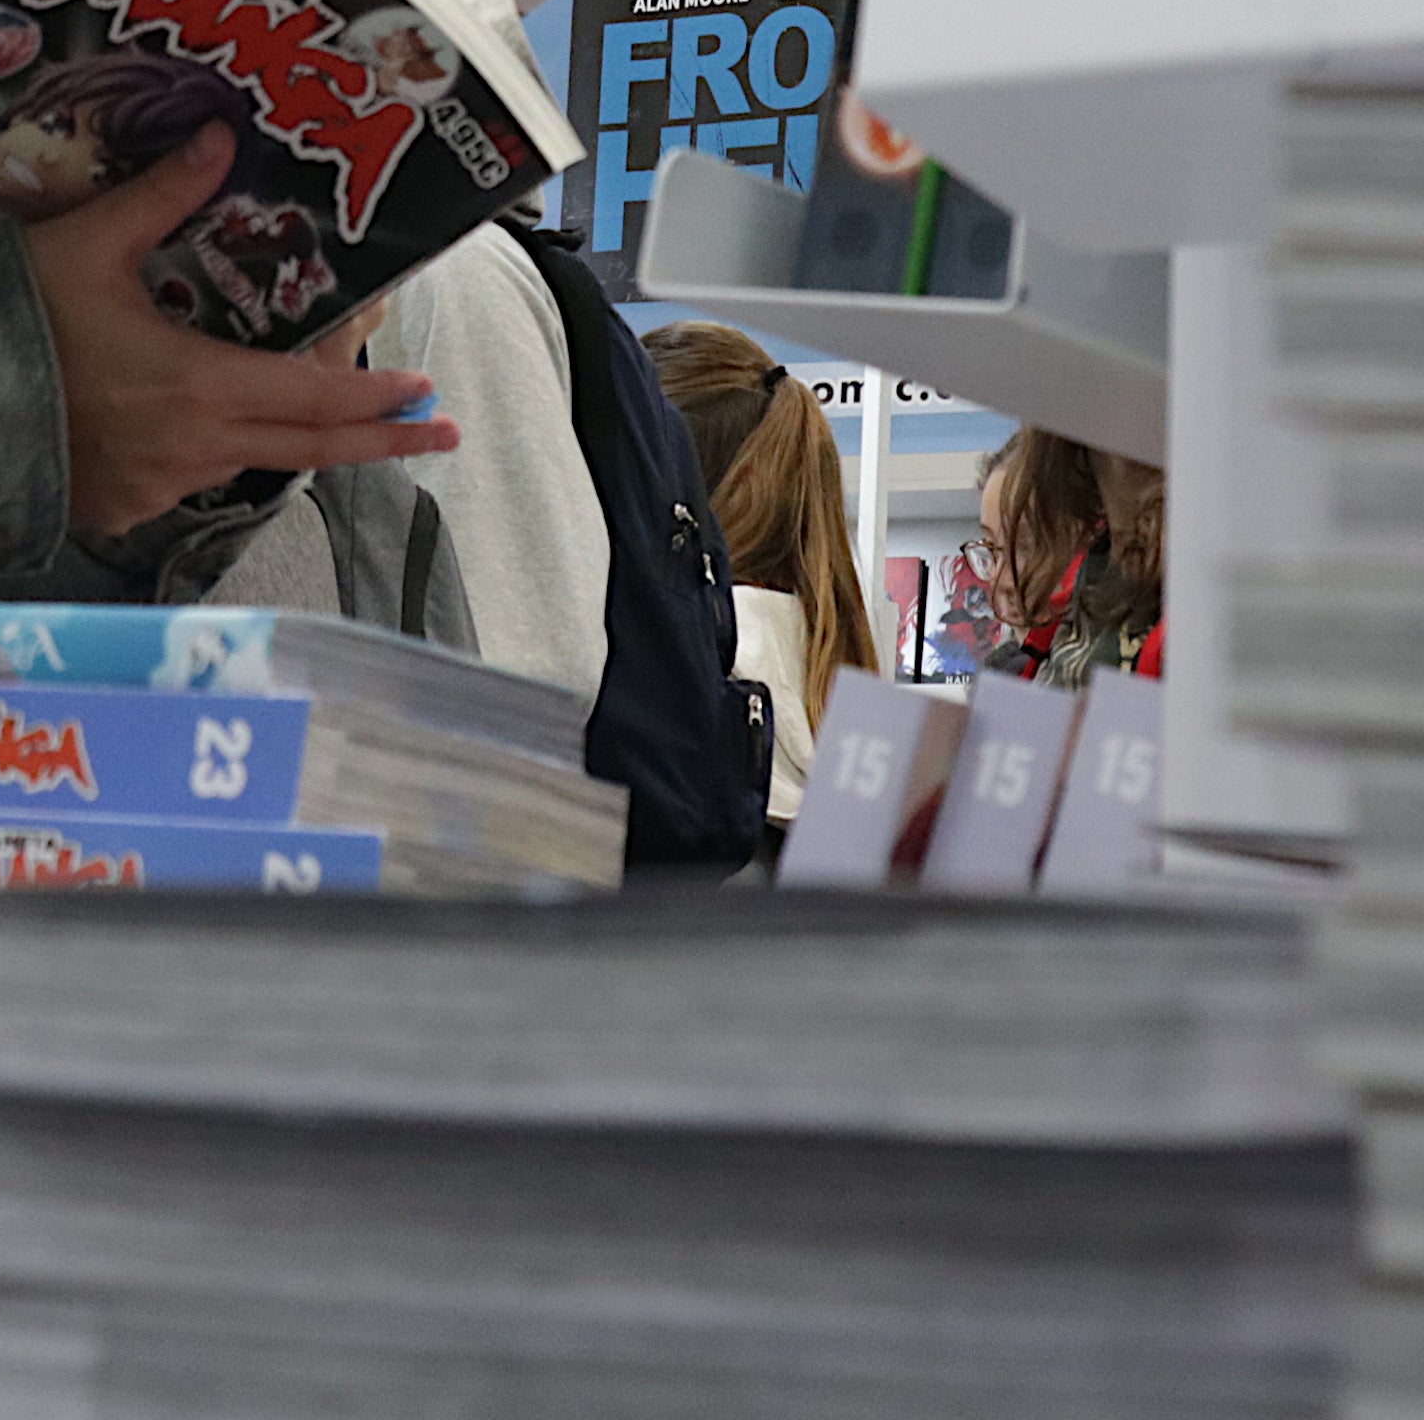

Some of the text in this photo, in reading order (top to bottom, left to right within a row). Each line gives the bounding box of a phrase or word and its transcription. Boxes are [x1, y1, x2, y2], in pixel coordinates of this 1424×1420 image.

[599, 5, 837, 126] FRO
[190, 716, 253, 800] 23
[835, 734, 892, 799] 15
[977, 739, 1035, 807] 15
[1094, 733, 1158, 801] 15
